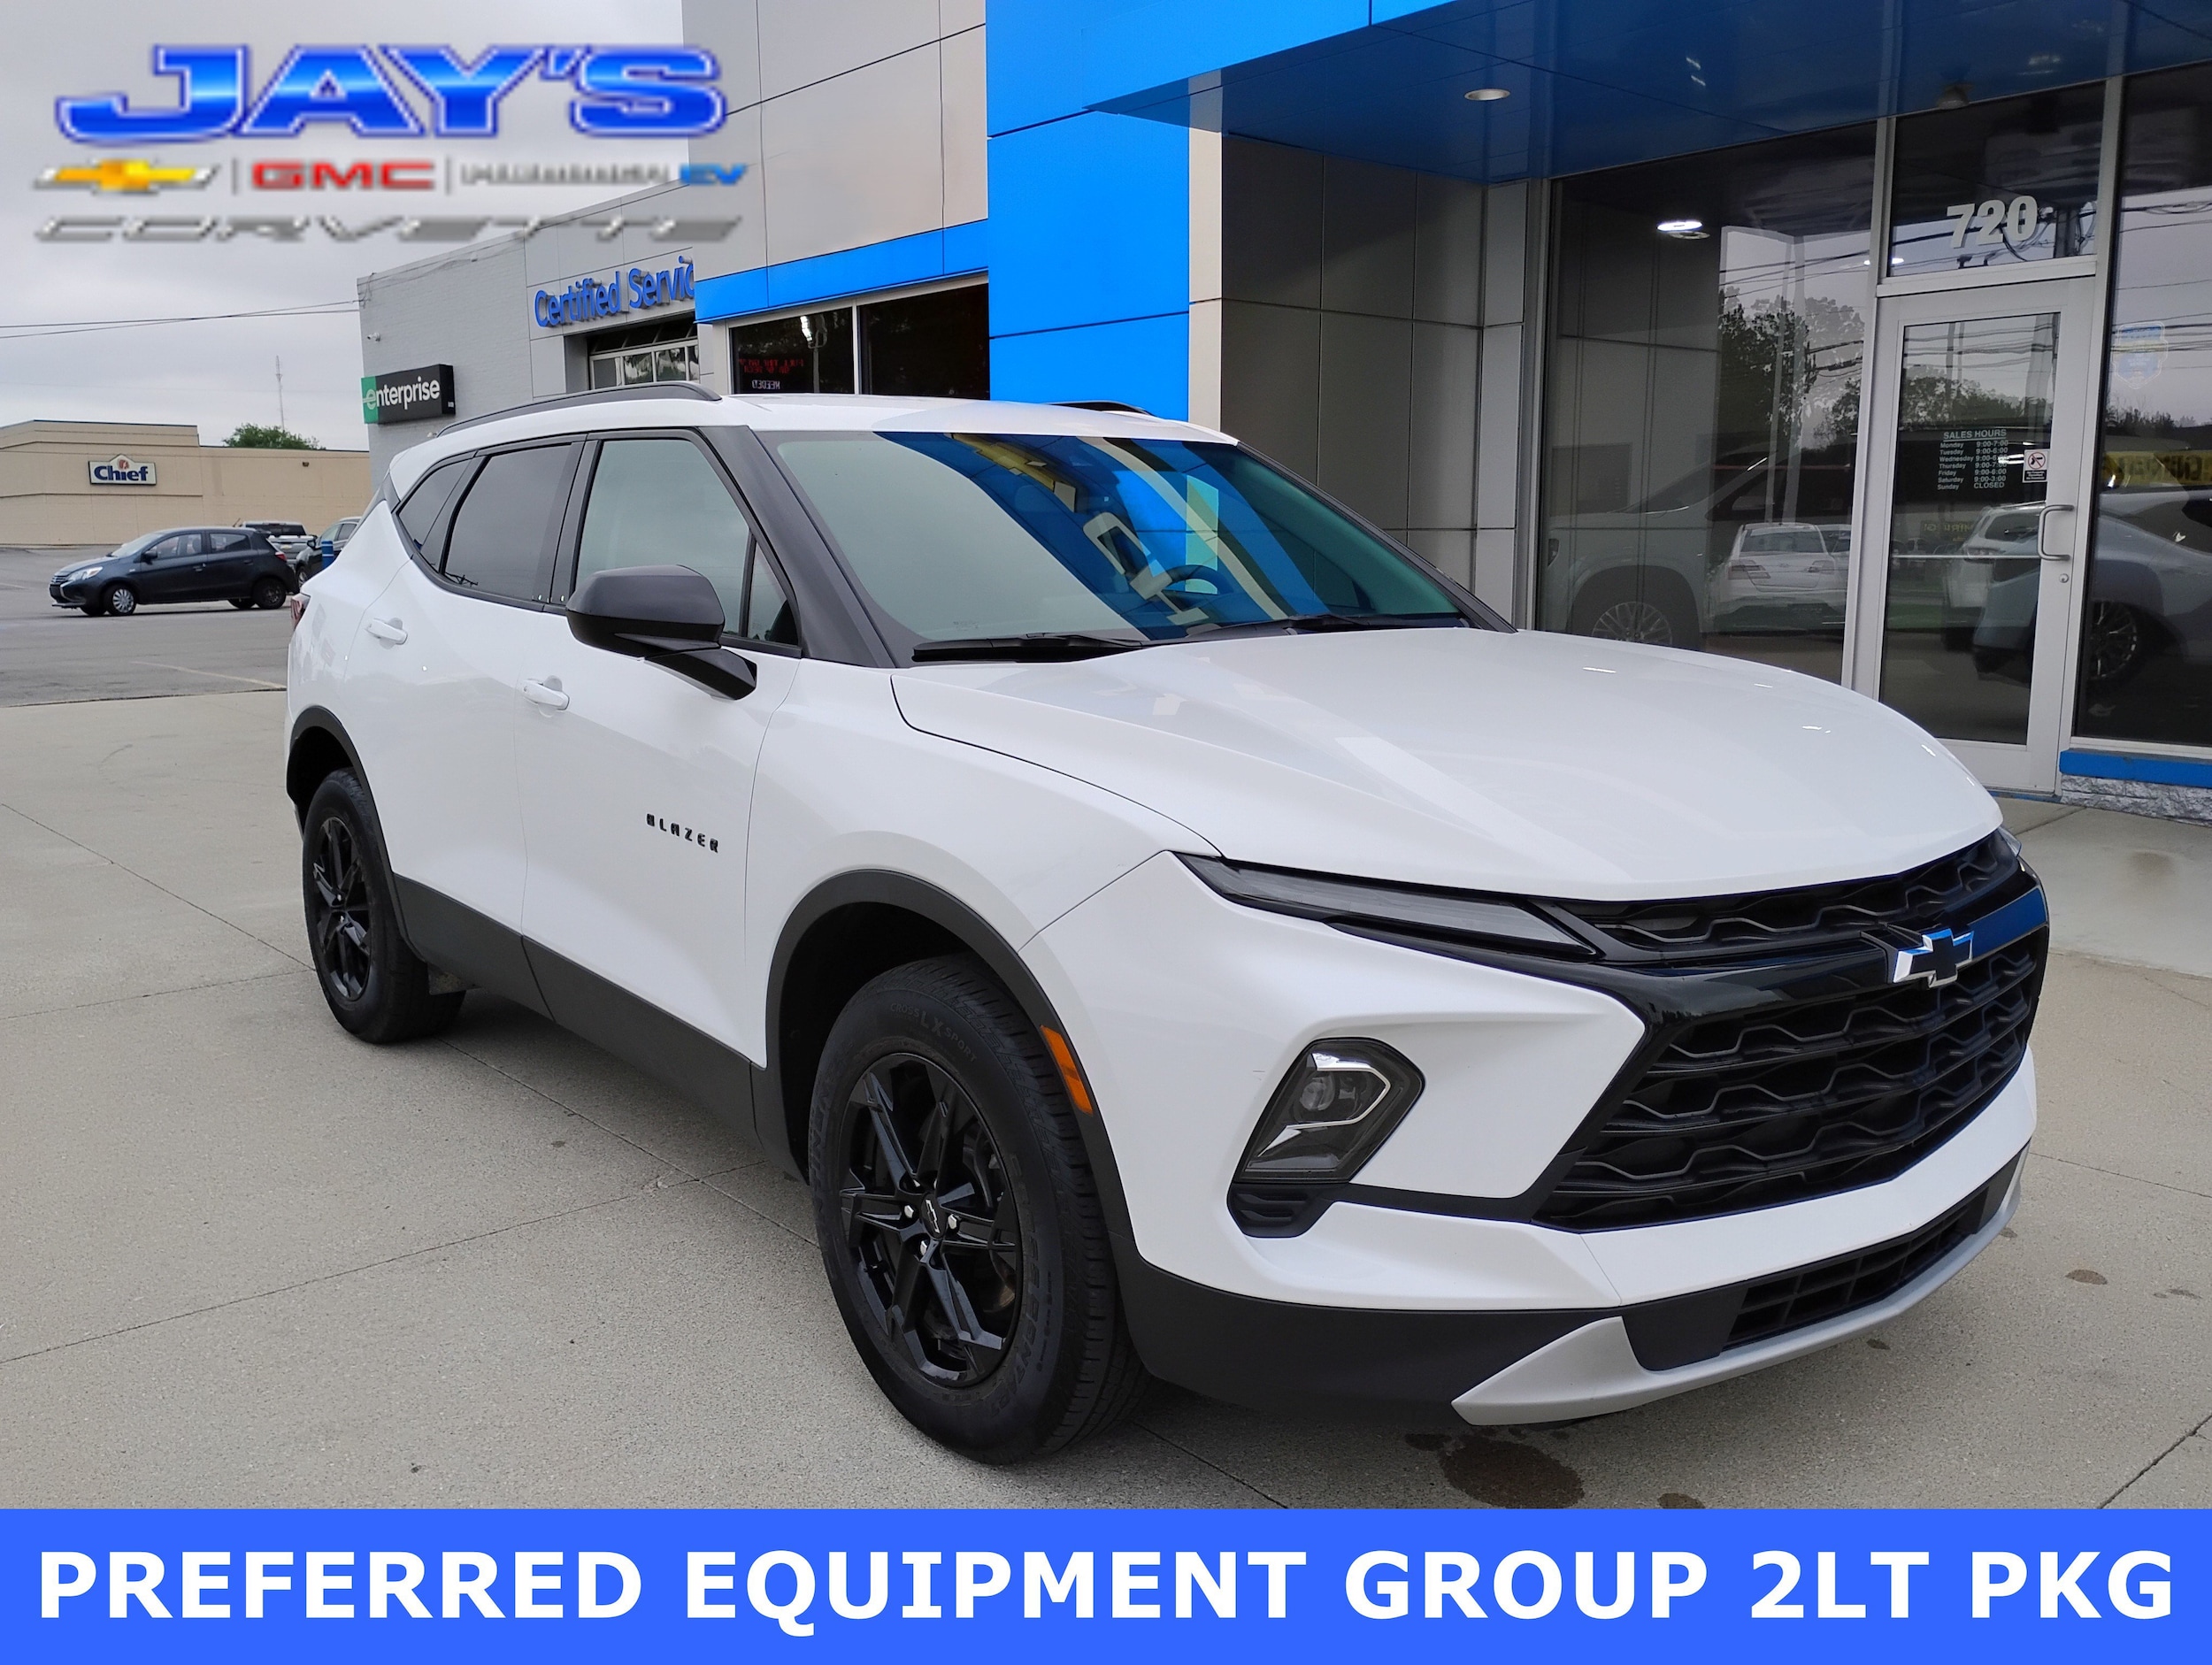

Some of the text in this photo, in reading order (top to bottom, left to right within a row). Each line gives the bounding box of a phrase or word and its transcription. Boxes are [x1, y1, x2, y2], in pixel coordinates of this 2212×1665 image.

[1947, 196, 2039, 249] 720
[534, 271, 621, 327] Certified
[364, 376, 441, 410] enterprise
[1943, 429, 2007, 440] SALES HOURS
[94, 464, 149, 481] Chief
[646, 813, 718, 854] BLAZER
[890, 1002, 920, 1018] CROSS
[943, 1026, 978, 1063] SPORT
